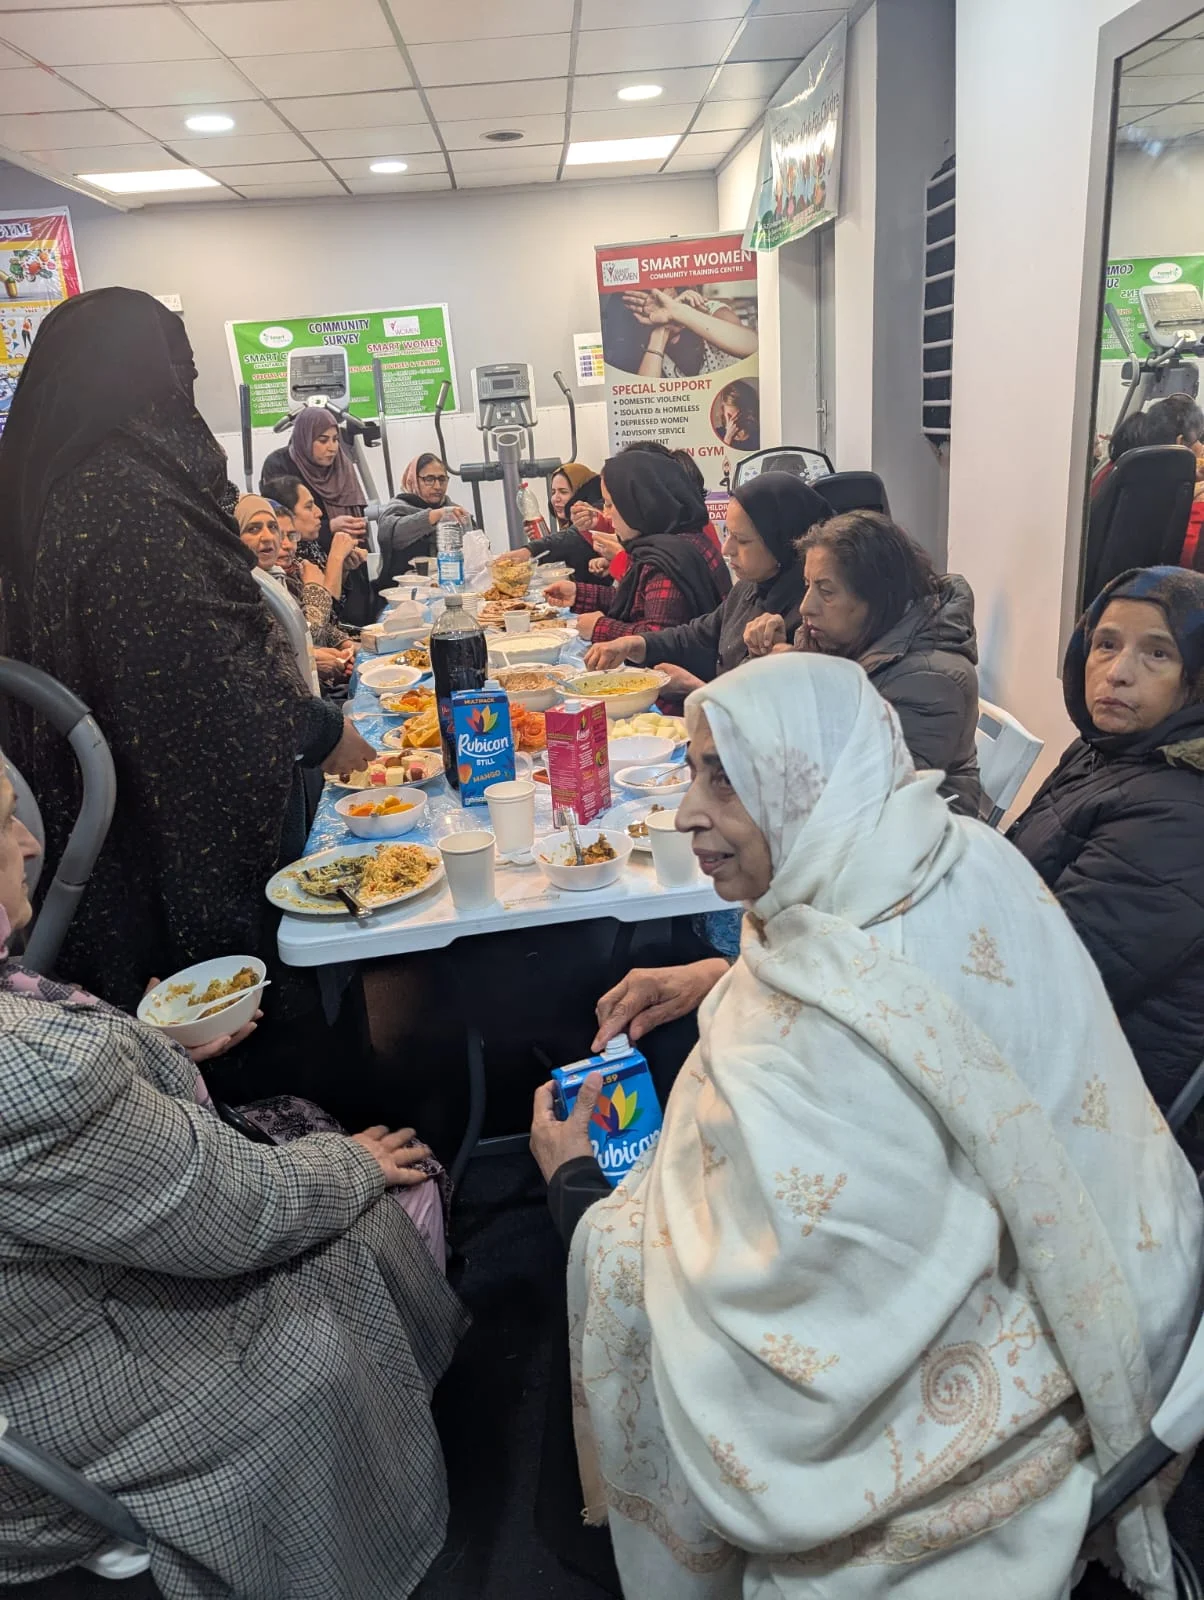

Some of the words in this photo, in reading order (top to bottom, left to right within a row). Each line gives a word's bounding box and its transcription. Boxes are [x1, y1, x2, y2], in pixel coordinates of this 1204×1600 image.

[641, 255, 689, 272] SMART
[693, 250, 752, 266] WOMEN
[650, 271, 688, 280] COMMUNITY
[689, 268, 719, 277] TRAINING
[719, 265, 744, 273] CENTRE
[309, 319, 369, 333] COMMUNITY
[323, 333, 359, 346] SURVEY
[368, 342, 400, 352] SMART
[403, 339, 442, 349] WOMEN
[244, 353, 277, 363] SMART
[612, 383, 657, 396] SPECIAL
[659, 379, 712, 393] SUPPORT
[619, 397, 656, 406] DOMESTIC
[656, 394, 691, 403] VIOLENCE
[620, 407, 654, 416] ISOLATED
[662, 405, 700, 414] HOMELESS
[620, 418, 659, 427] DEPRESSED
[660, 416, 689, 424] WOMEN
[621, 429, 656, 437] ADVISORY
[657, 426, 686, 435] SERVICE
[698, 446, 724, 457] GYM
[706, 504, 728, 512] HILDR
[709, 511, 727, 520] DAY
[458, 734, 509, 756] Rubicon
[476, 758, 495, 766] STILL
[473, 769, 501, 783] MANGO
